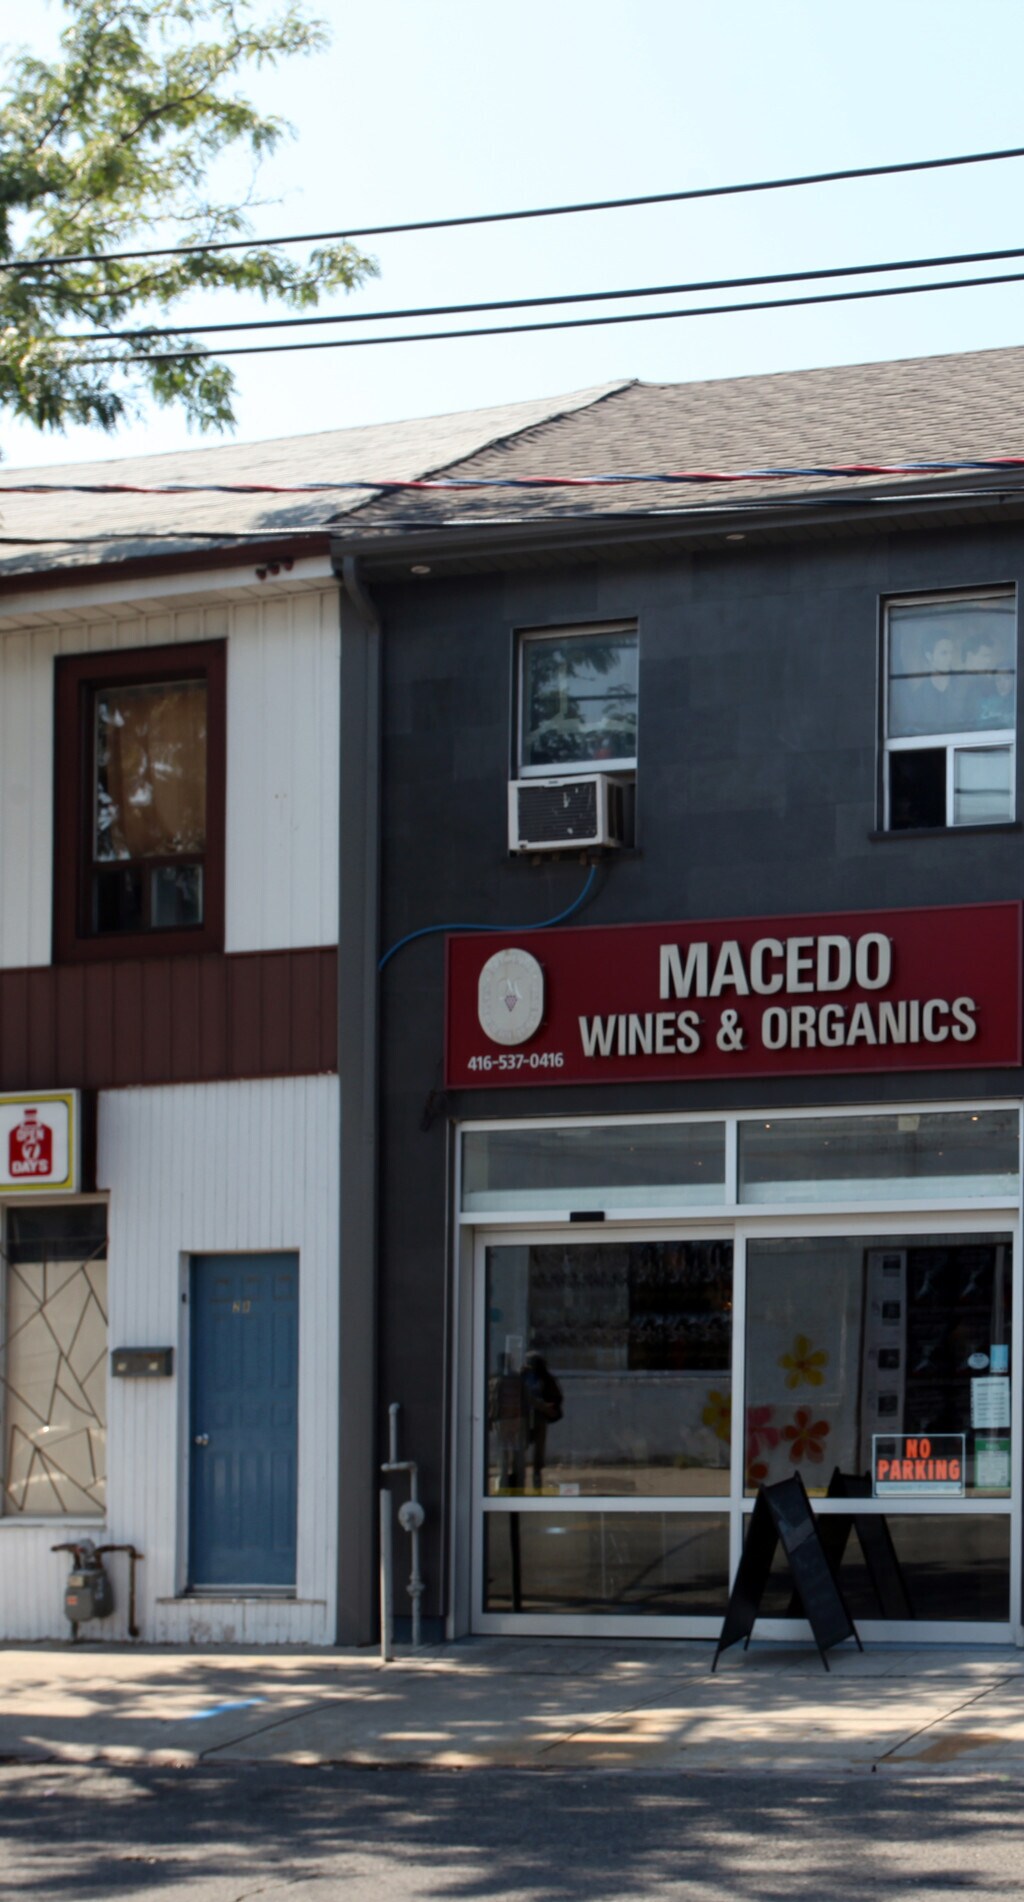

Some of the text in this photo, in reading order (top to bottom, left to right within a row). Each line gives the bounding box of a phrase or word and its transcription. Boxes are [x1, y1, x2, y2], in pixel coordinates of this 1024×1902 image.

[659, 932, 893, 999] MACEDO
[578, 996, 978, 1058] WINES & ORGANICS
[467, 1051, 564, 1071] 416-537-0416
[12, 1159, 48, 1174] DAYS
[905, 1438, 931, 1458] NO
[877, 1459, 960, 1481] PARKING
